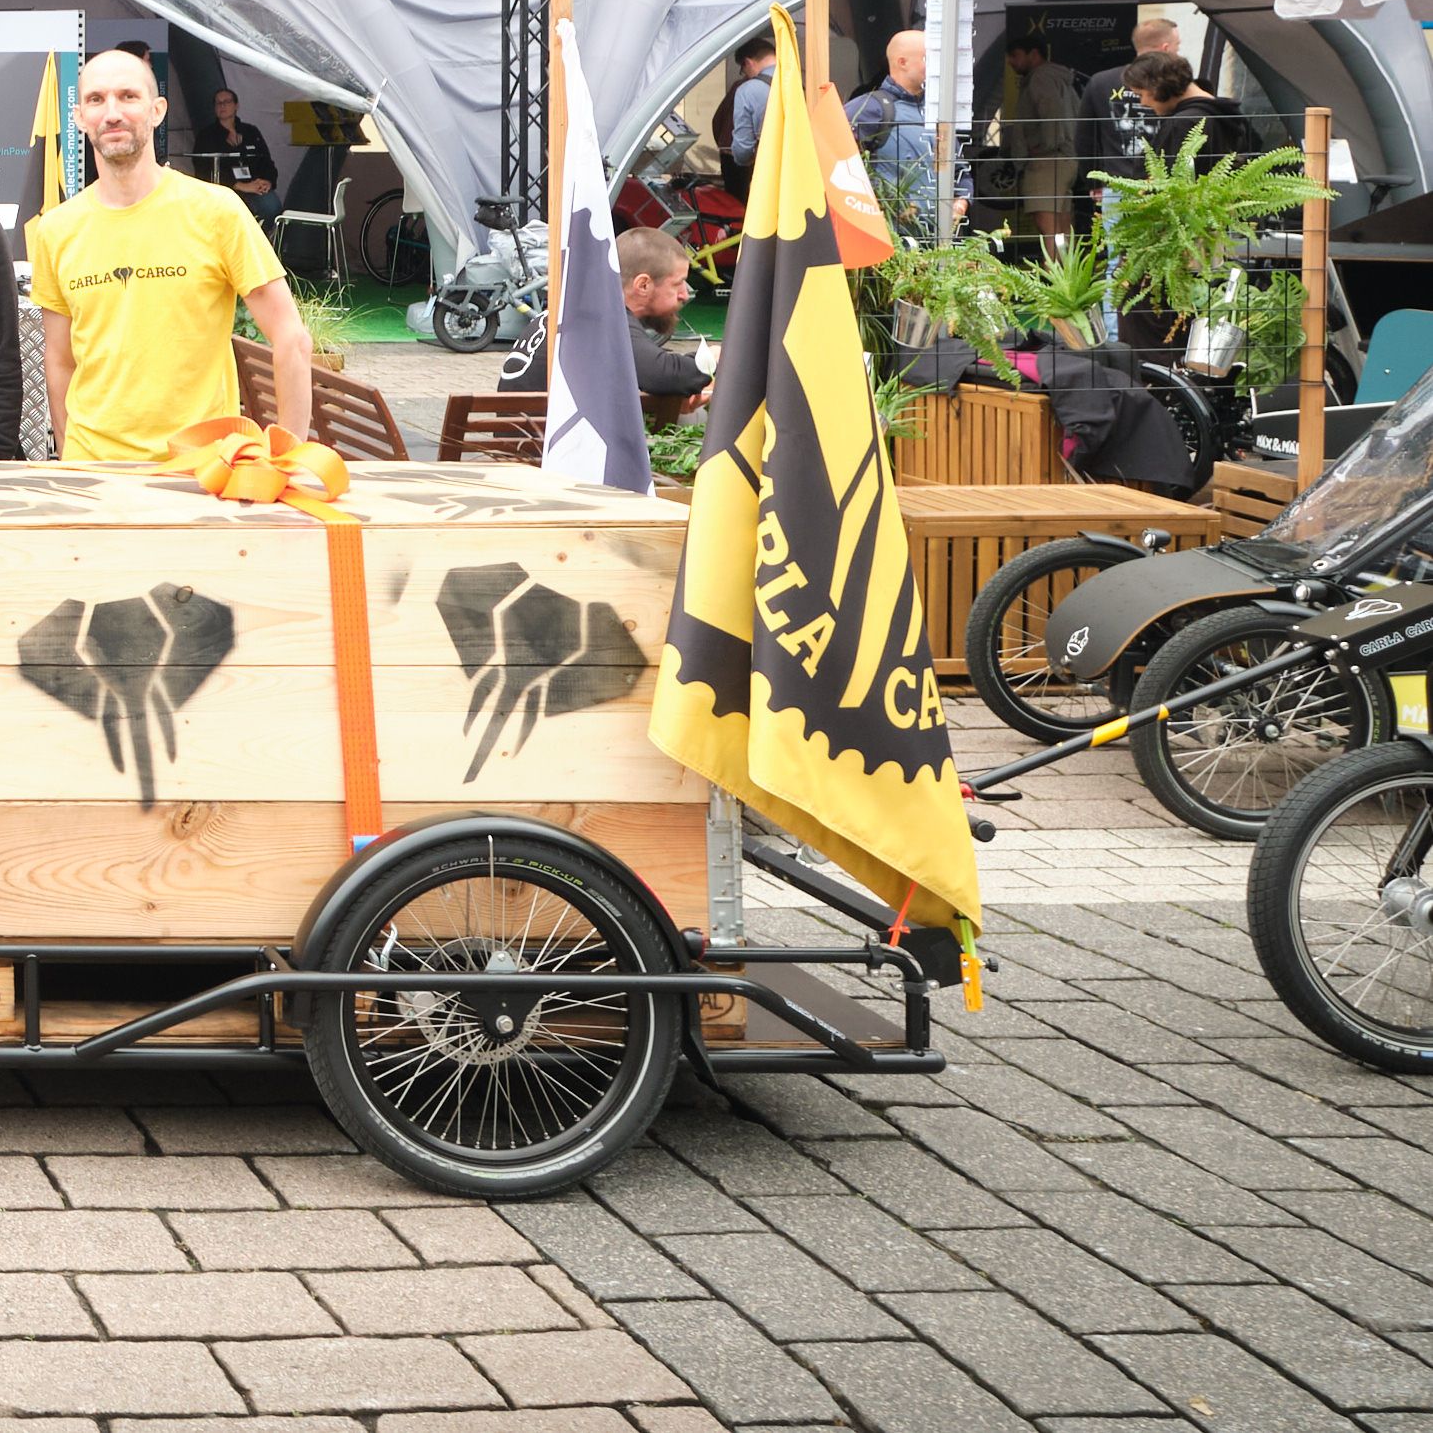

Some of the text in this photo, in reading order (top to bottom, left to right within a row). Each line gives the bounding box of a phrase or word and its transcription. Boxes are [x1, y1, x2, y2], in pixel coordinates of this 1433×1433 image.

[66, 86, 76, 199] -electric-motors.com
[845, 195, 883, 216] CARL
[69, 266, 187, 290] CARLA CARGO
[1359, 616, 1433, 657] CARLA CAR
[432, 856, 583, 886] SCHWALBE PICK-UP
[699, 993, 723, 1010] AL
